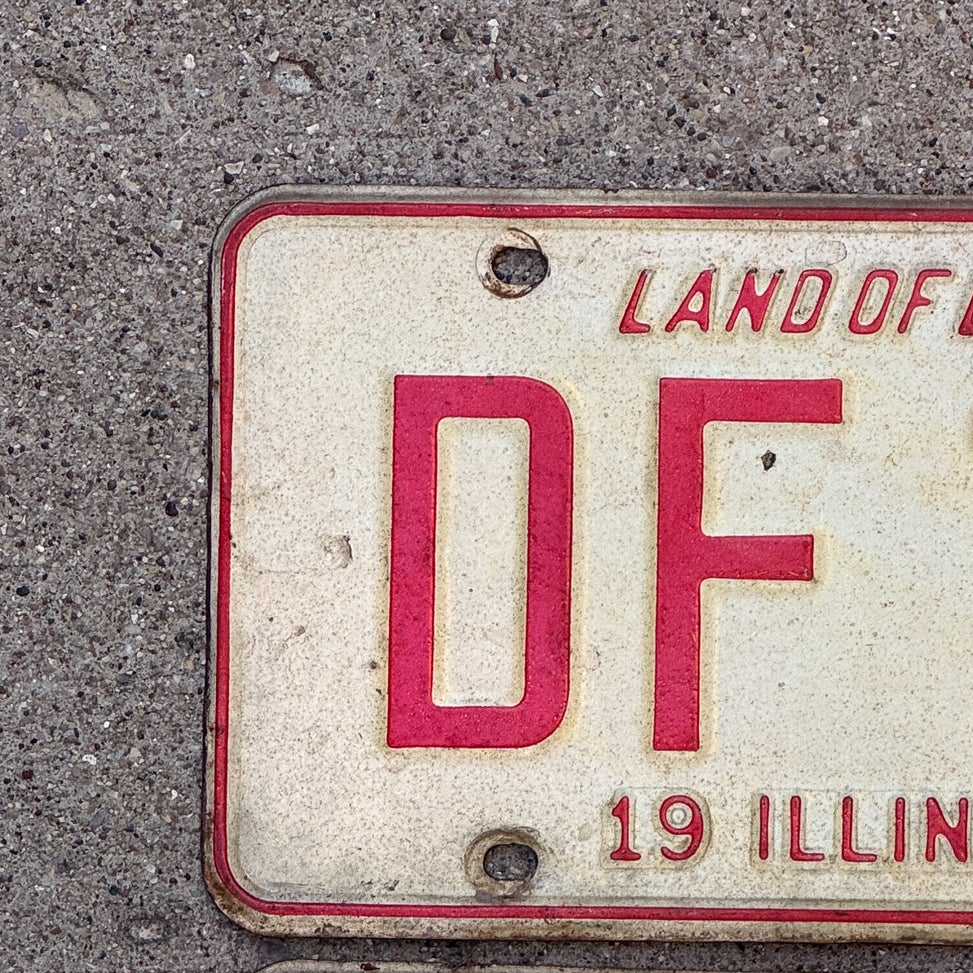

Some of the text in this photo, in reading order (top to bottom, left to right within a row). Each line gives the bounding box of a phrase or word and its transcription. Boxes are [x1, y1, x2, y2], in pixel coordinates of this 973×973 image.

[618, 267, 833, 335] LAND
[847, 267, 952, 335] OF
[386, 374, 843, 753] DF
[608, 794, 705, 863] 19
